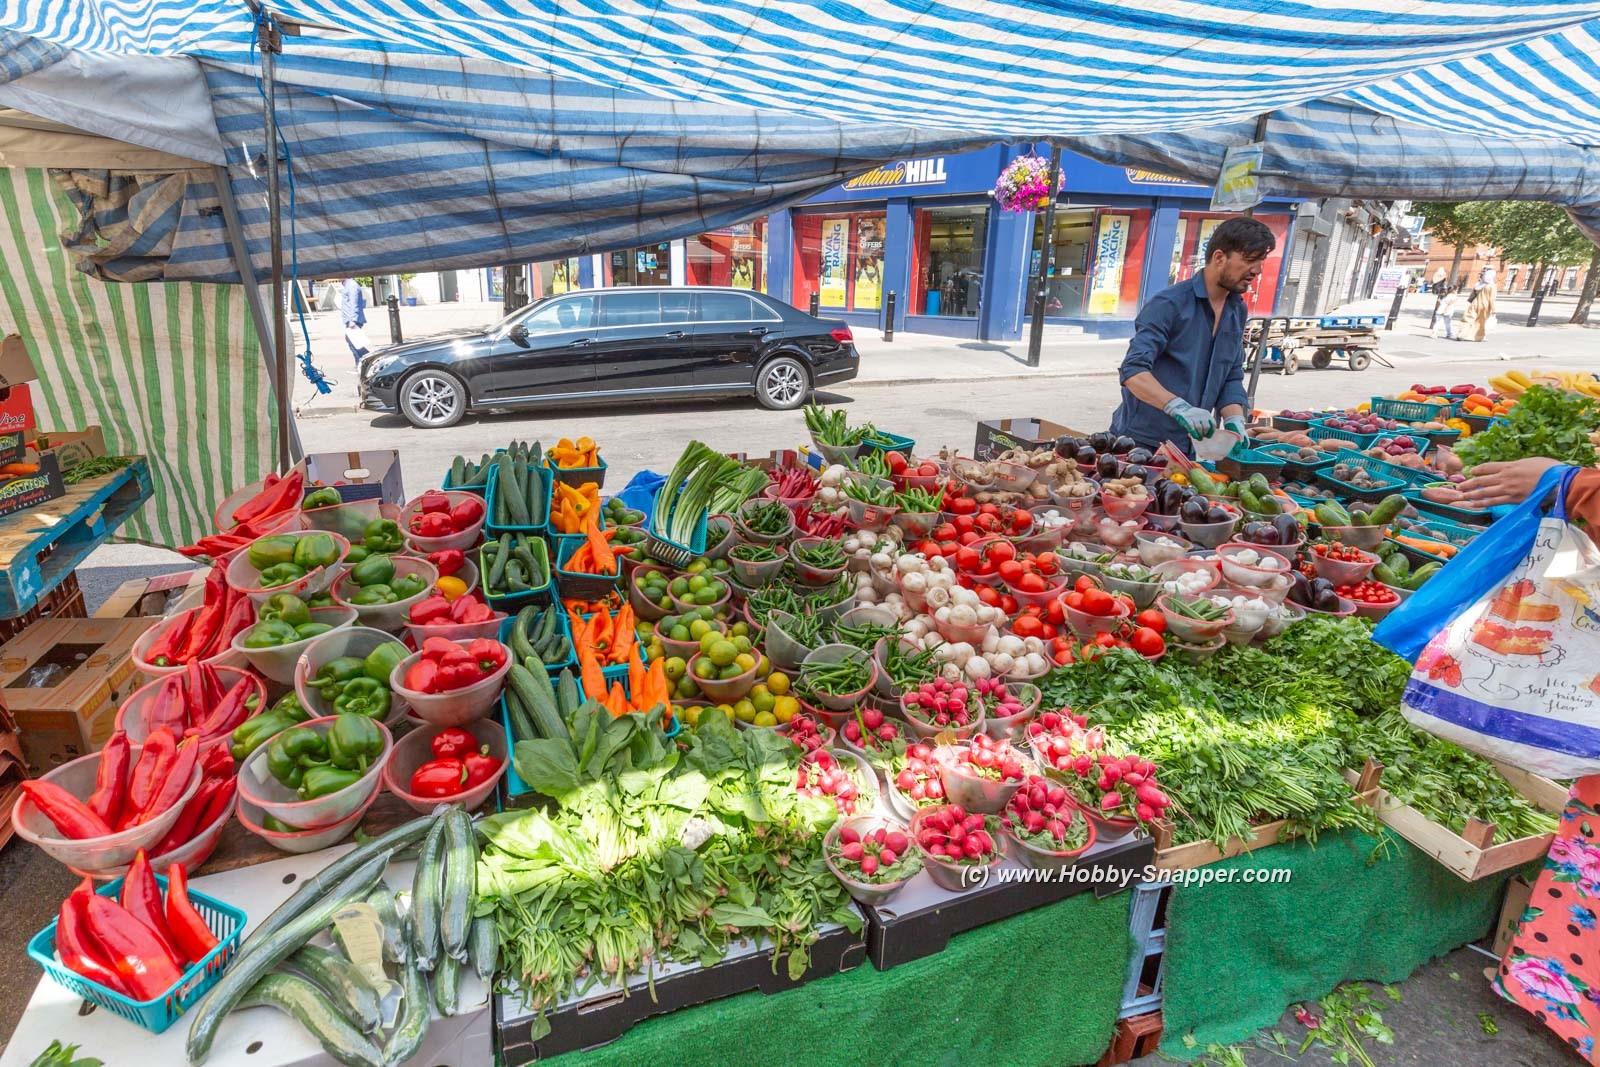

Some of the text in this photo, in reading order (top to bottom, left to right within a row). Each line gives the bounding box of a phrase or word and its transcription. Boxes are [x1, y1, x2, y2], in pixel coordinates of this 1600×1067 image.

[906, 158, 947, 183] HILL
[824, 233, 833, 285] FESTIVAL
[832, 223, 841, 267] RACING
[1096, 229, 1112, 289] FESTIVAL
[1107, 220, 1122, 269] RACING
